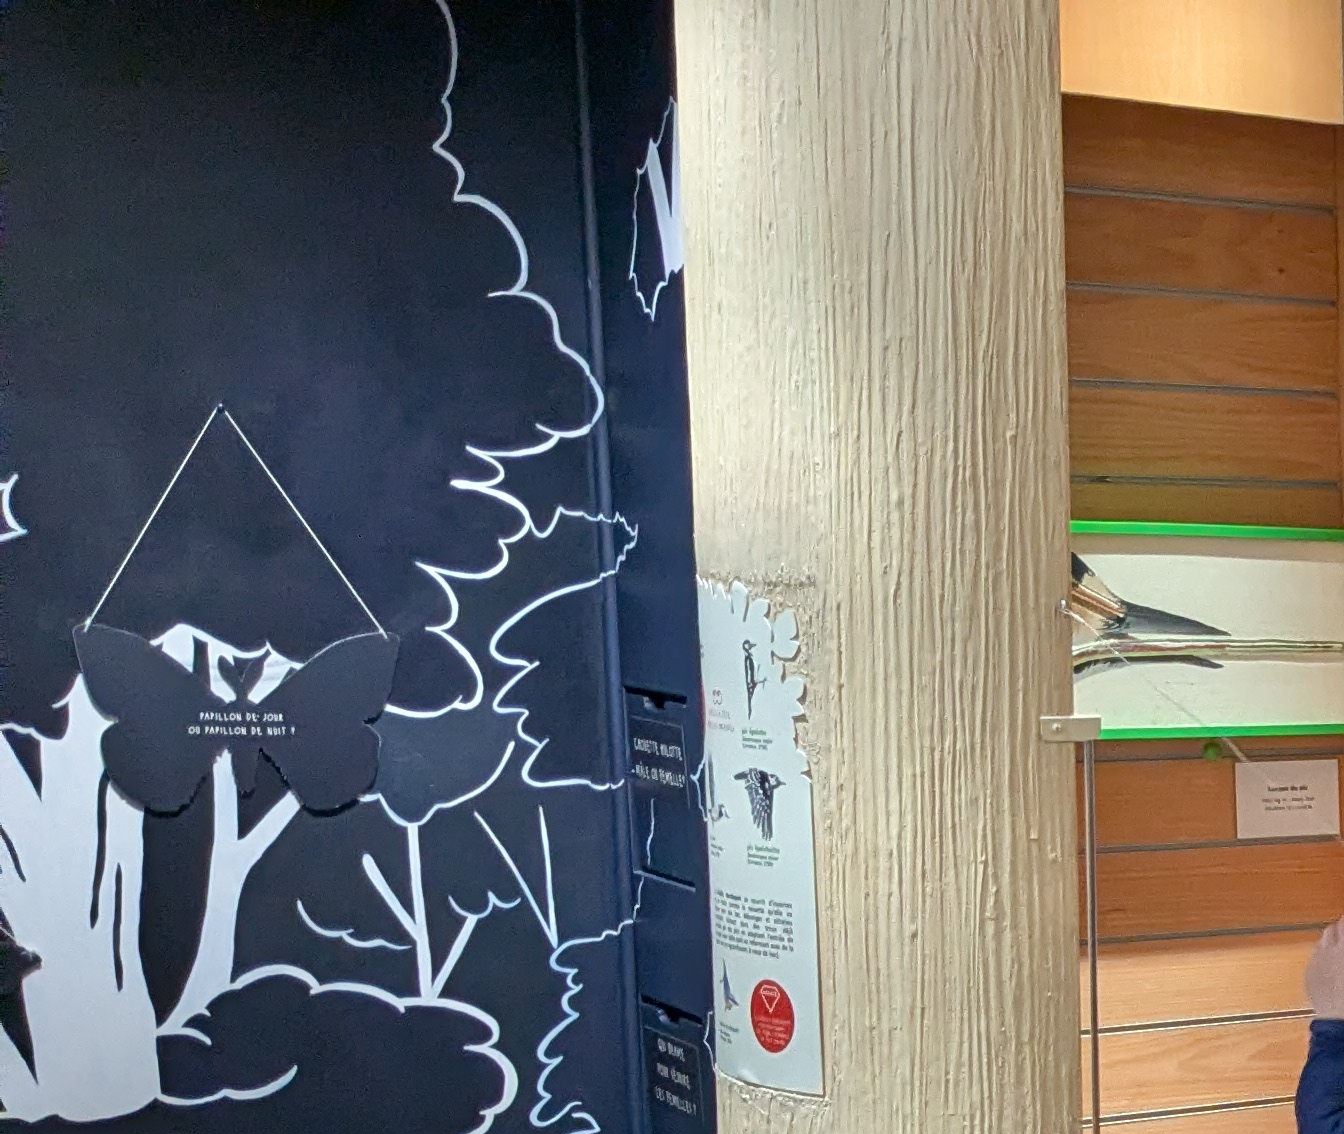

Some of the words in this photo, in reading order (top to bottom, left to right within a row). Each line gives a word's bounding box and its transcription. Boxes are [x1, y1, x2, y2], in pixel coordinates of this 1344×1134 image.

[200, 711, 242, 721] PAPILLON
[204, 726, 247, 735] PAPILLON
[251, 727, 262, 735] DE
